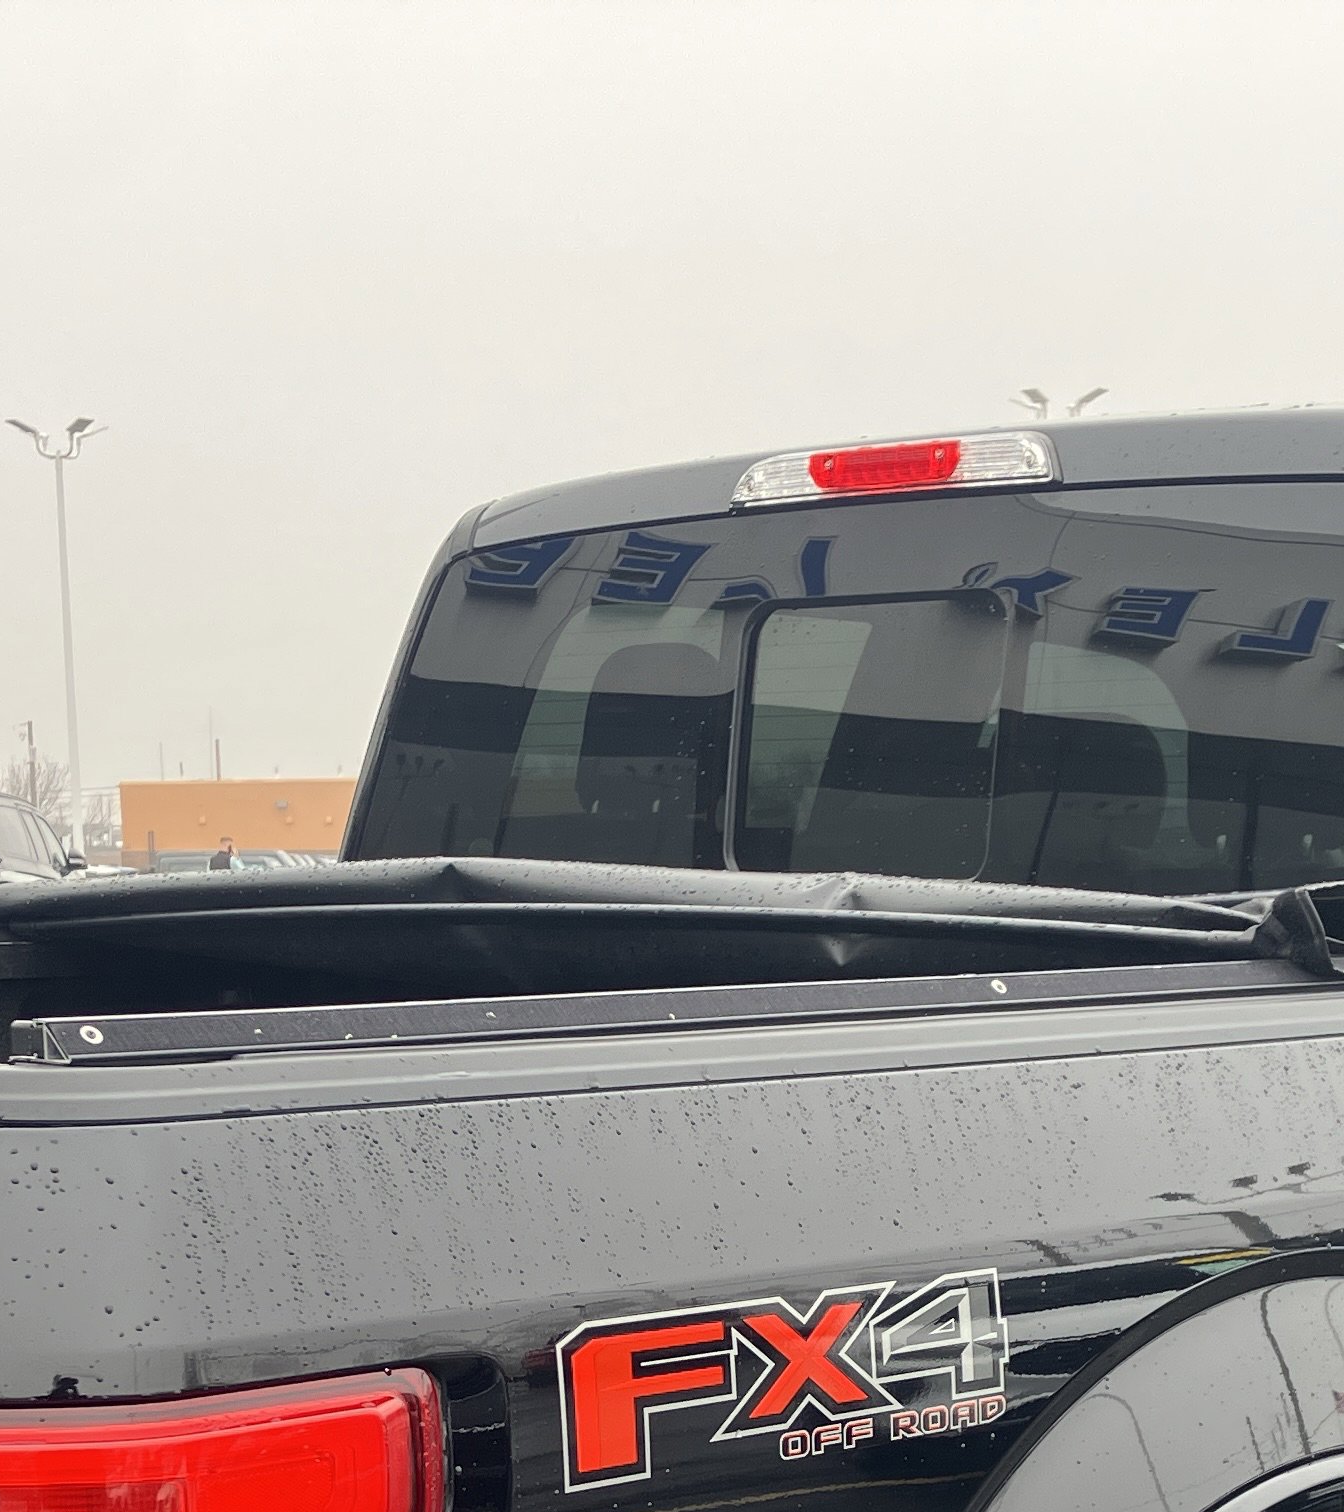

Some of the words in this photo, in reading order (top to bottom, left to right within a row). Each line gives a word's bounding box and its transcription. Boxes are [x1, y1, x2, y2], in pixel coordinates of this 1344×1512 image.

[556, 1266, 1010, 1493] FX4
[779, 1417, 875, 1461] OFF
[890, 1393, 1008, 1441] ROAD
